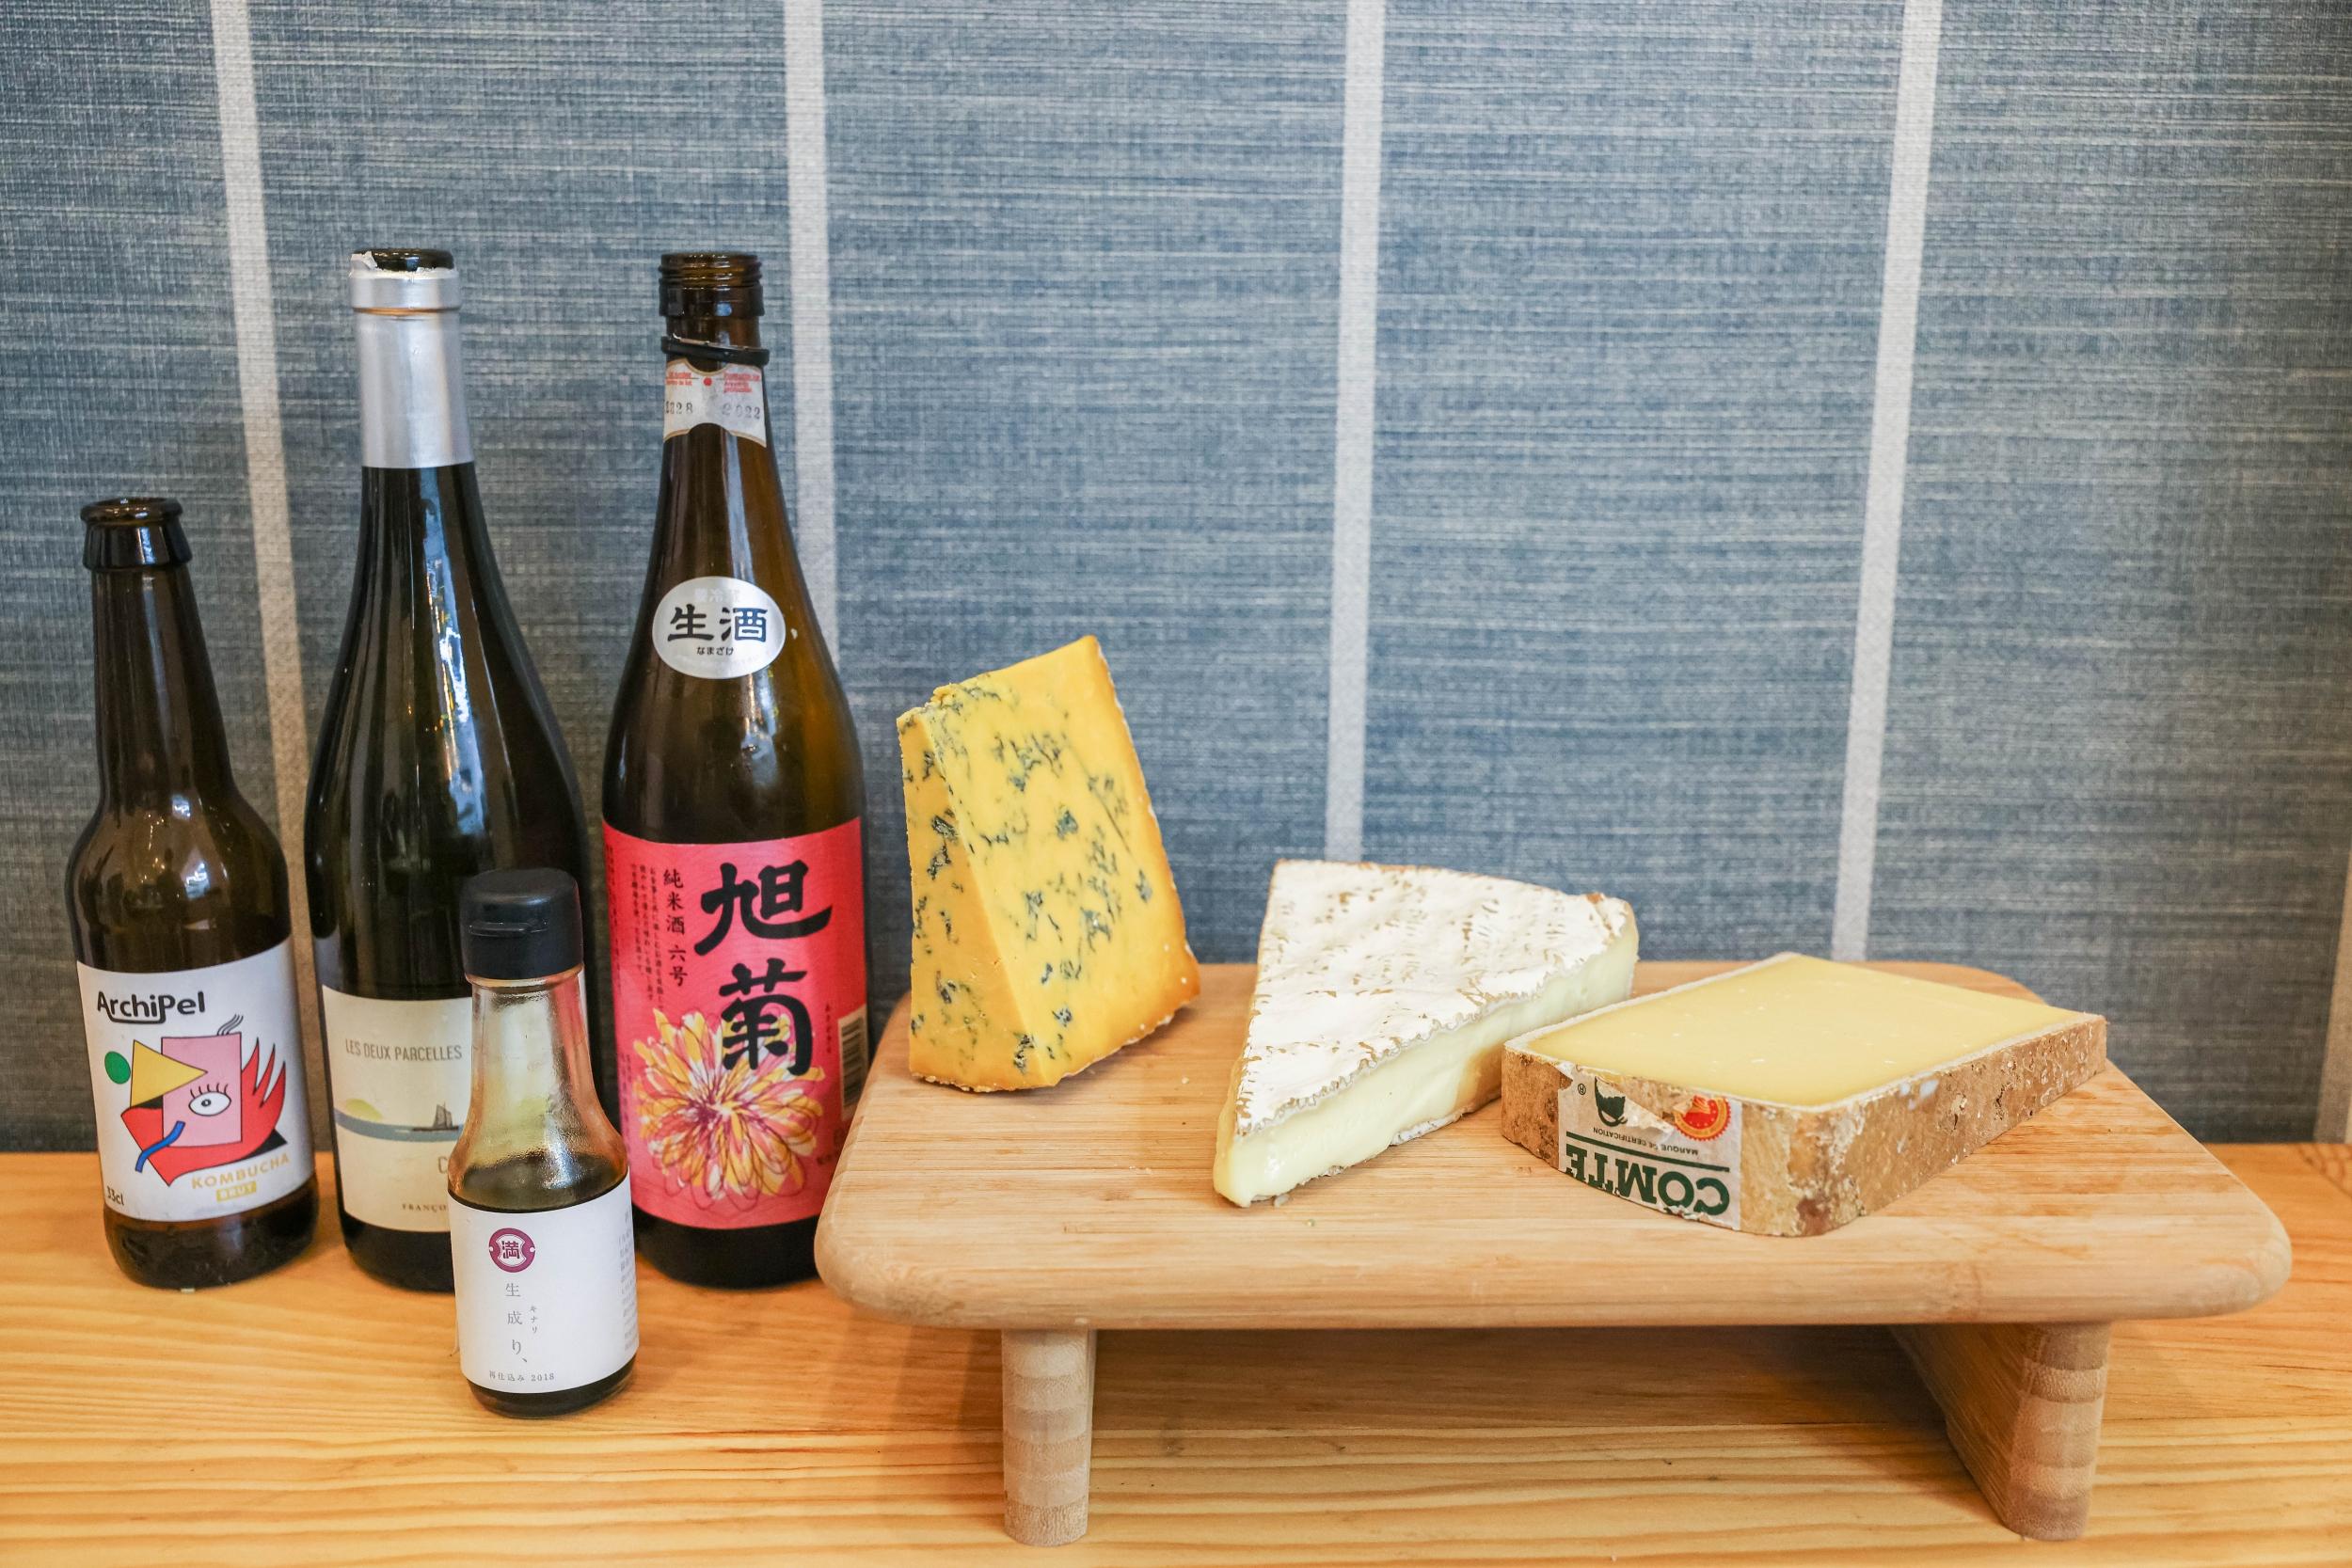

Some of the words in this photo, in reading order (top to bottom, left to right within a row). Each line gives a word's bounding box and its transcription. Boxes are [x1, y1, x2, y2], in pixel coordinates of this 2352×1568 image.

[722, 402, 761, 420] 2022
[667, 603, 768, 642] 生酒
[696, 646, 734, 656] なまざけ
[663, 868, 685, 935] 純米酒
[667, 944, 688, 987] 六号
[693, 860, 833, 1076] 旭菊
[344, 1038, 361, 1055] LES
[363, 1042, 391, 1061] DEUX
[394, 1045, 463, 1062] PARCELLES
[1593, 1127, 1648, 1148] CERTIFICATION
[1661, 1145, 1699, 1155] MARQUE
[191, 1152, 290, 1189] KOMBUCHA
[106, 1185, 124, 1206] 33cl
[501, 1240, 520, 1259] 満
[530, 1305, 538, 1334] キナリ
[531, 1372, 555, 1382] 2018
